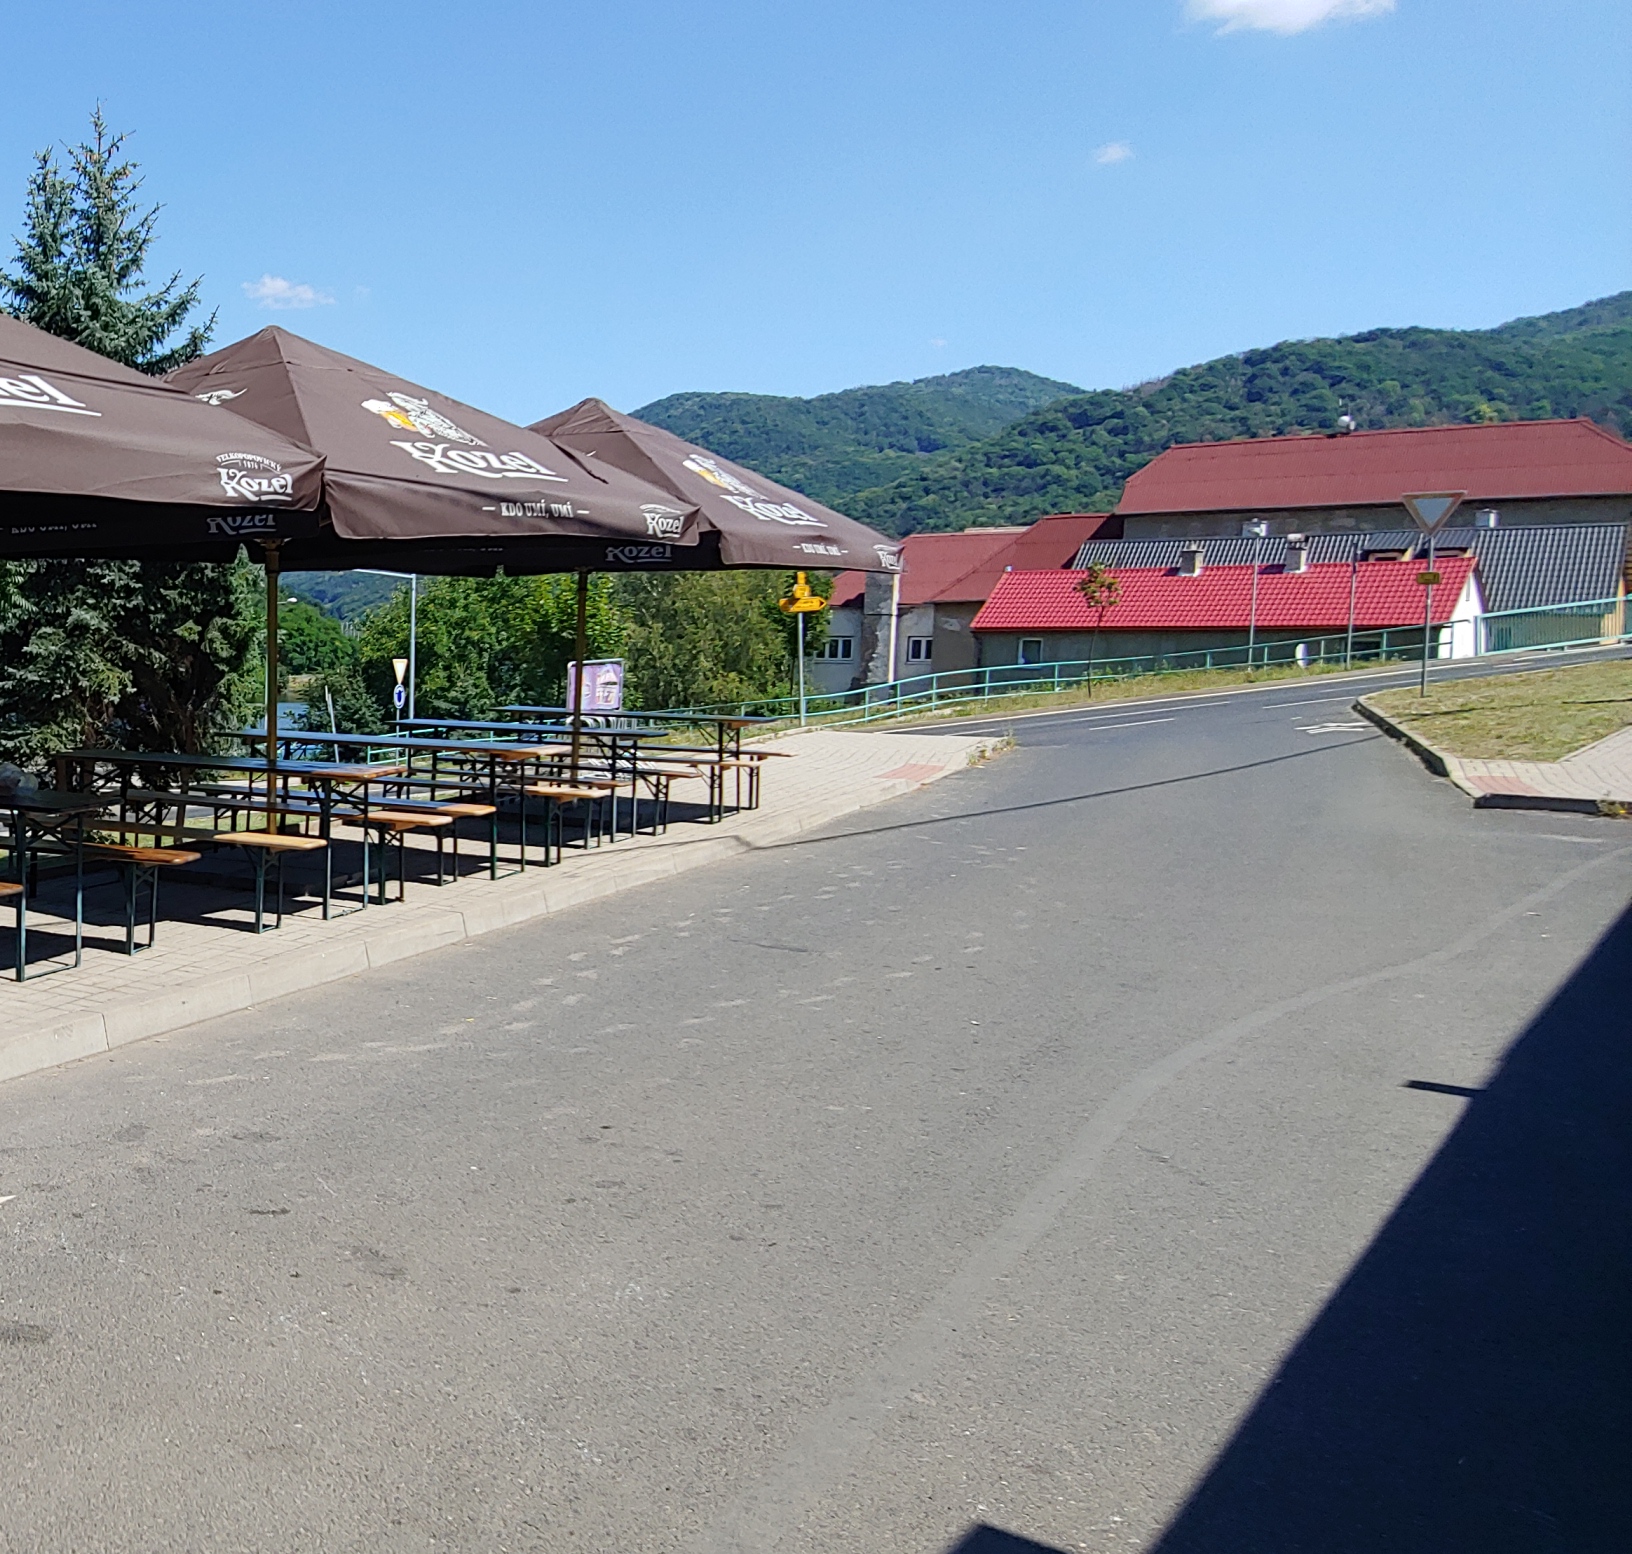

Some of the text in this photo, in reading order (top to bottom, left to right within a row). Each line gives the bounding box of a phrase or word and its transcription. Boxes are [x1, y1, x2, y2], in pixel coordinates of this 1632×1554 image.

[389, 441, 557, 478] Kozel
[216, 467, 294, 502] Kozel
[500, 502, 523, 517] KDO
[642, 512, 685, 538] Kozel
[720, 494, 819, 525] Kozel
